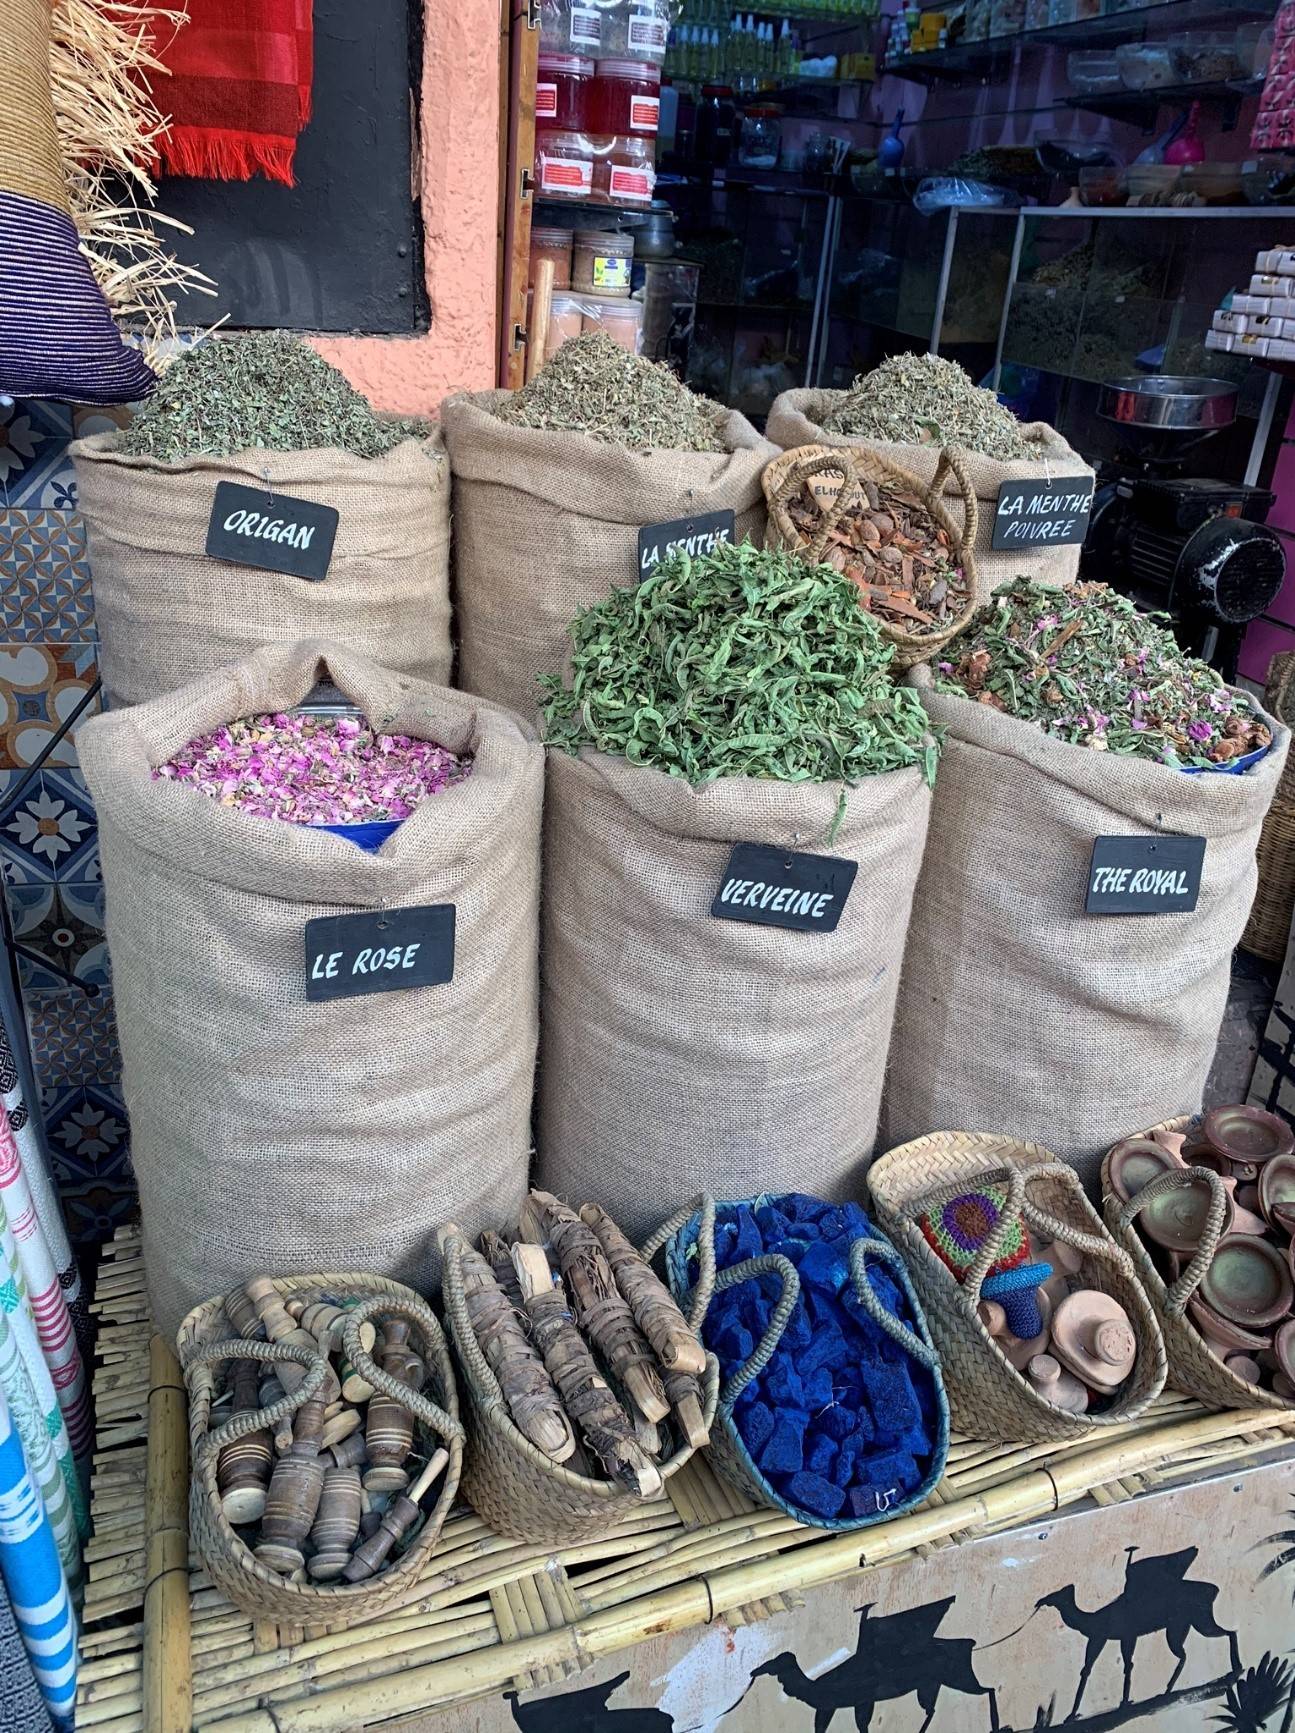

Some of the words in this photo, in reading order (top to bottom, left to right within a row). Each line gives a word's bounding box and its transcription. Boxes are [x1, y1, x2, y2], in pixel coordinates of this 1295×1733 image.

[998, 495, 1024, 516] LA
[1026, 494, 1092, 515] MENTHE
[223, 509, 316, 550] ORIGAN
[1003, 519, 1077, 540] POIVREE
[641, 544, 660, 569] LA
[1092, 867, 1132, 894] THE
[1128, 868, 1189, 895] ROYAL
[721, 878, 834, 918] VERVEINE
[311, 951, 344, 980] LE
[351, 943, 421, 975] ROSE
